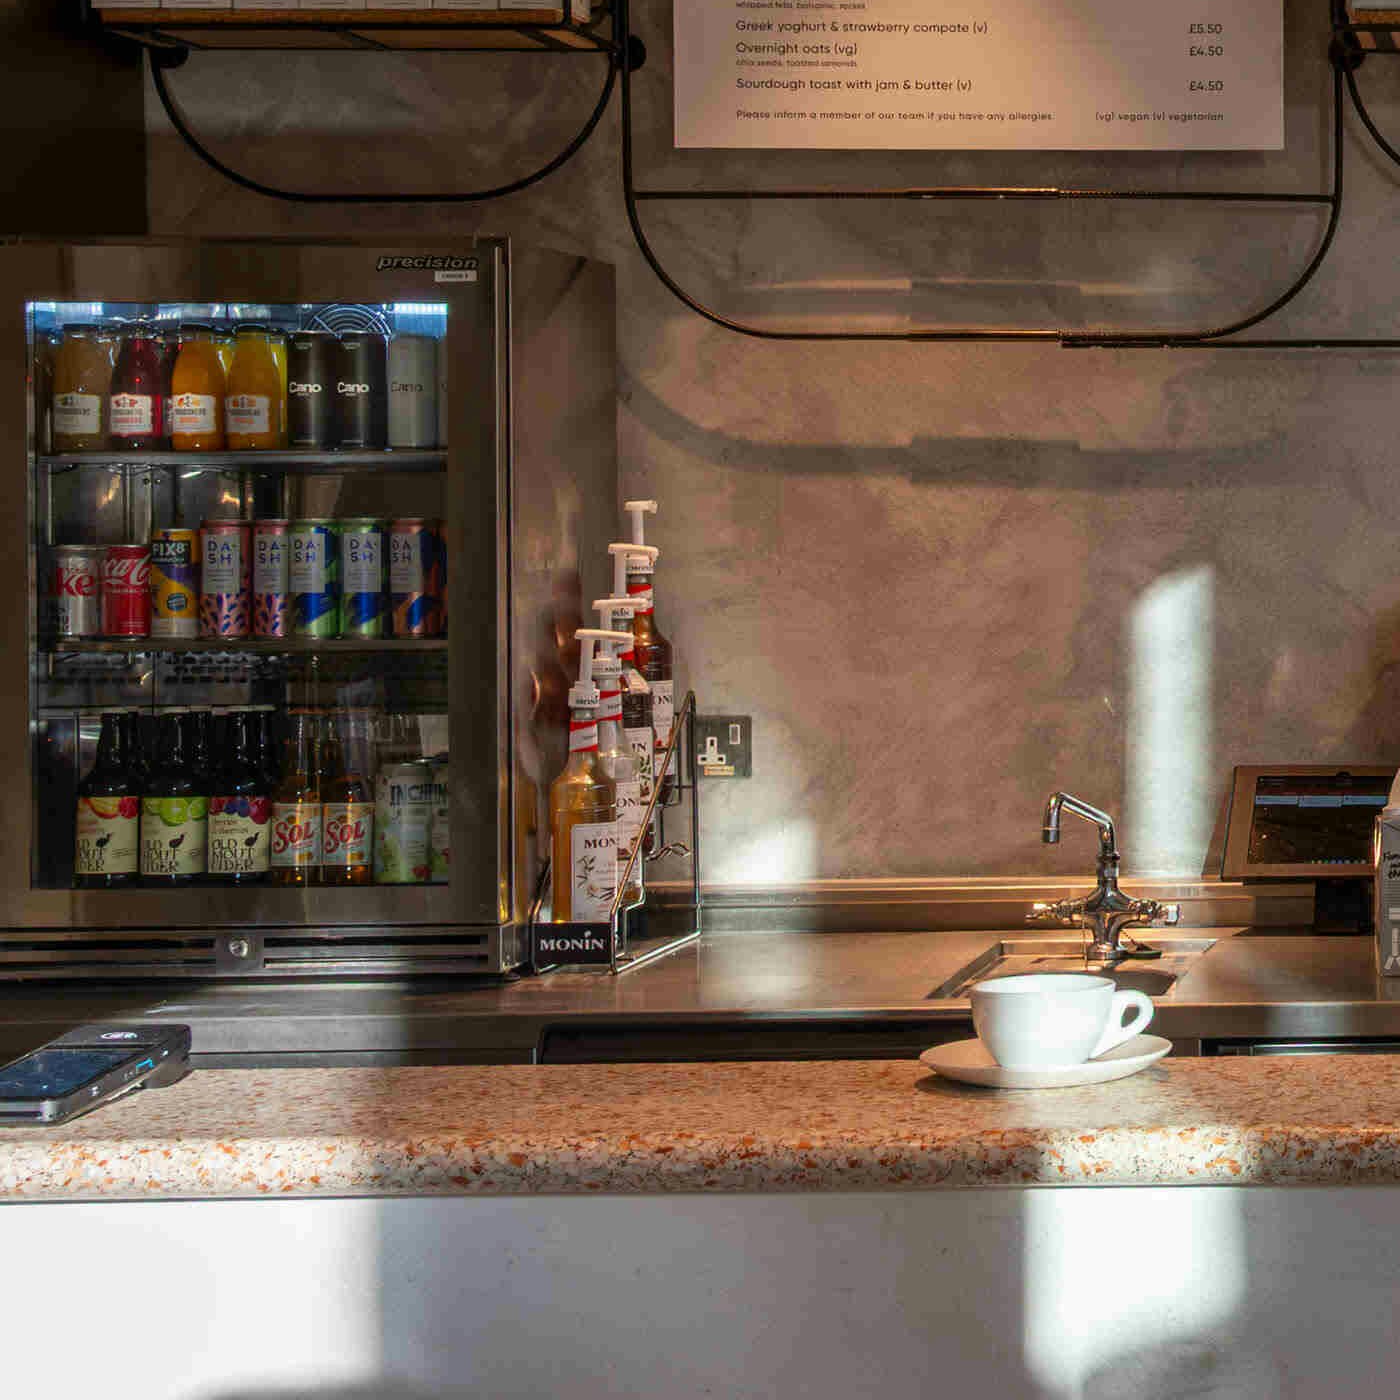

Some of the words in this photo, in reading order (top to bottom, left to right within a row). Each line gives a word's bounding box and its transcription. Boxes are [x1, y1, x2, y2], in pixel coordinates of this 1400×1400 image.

[736, 21, 773, 32] Greek
[777, 22, 826, 34] yoghurt
[830, 23, 839, 32] &
[843, 22, 909, 35] strawberry
[914, 23, 969, 36] compote
[973, 22, 988, 34] (v)
[736, 43, 798, 56] Overnight
[802, 45, 830, 54] oats
[834, 44, 857, 56] (vg)
[1190, 47, 1224, 57] £4.50
[736, 78, 805, 92] Sourdough
[810, 80, 841, 89] toast
[846, 79, 872, 90] with
[875, 80, 899, 92] jam
[903, 80, 911, 90] &
[915, 80, 953, 90] butter
[957, 80, 972, 92] (v)
[1189, 81, 1224, 91] £4.50
[737, 110, 770, 119] Please
[774, 110, 806, 119] inform
[820, 111, 861, 120] member
[865, 112, 875, 120] of
[899, 112, 924, 120] team
[927, 112, 933, 120] if
[936, 114, 955, 122] you
[959, 112, 983, 120] have
[987, 112, 1004, 122] any
[1118, 113, 1149, 122] vegan
[1168, 113, 1224, 121] vegetarian
[376, 255, 478, 272] precision
[289, 382, 322, 393] Cano
[337, 382, 370, 393] Cano
